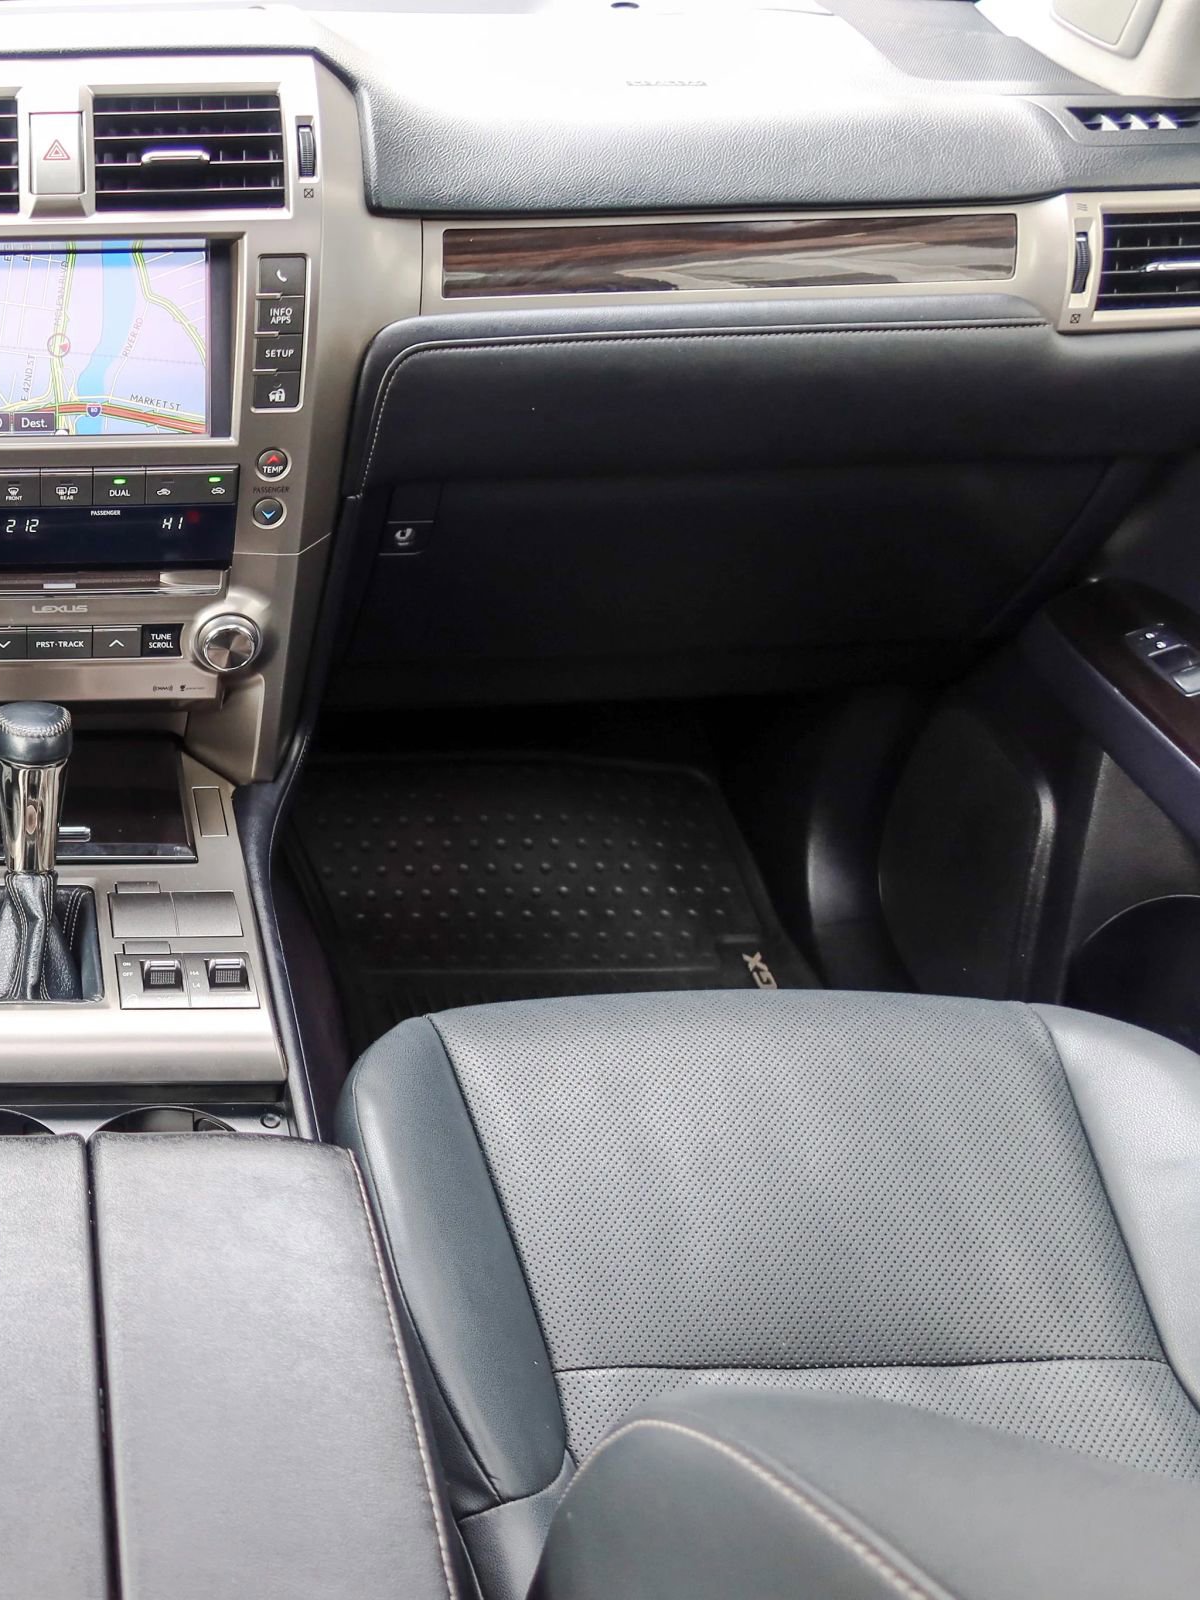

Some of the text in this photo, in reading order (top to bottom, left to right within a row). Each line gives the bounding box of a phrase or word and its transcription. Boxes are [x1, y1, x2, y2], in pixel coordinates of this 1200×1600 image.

[269, 307, 293, 317] INFO
[270, 316, 292, 325] APPS
[122, 331, 140, 358] RIVER
[264, 349, 295, 358] SETUP
[130, 394, 181, 411] MARKET ST
[21, 418, 48, 428] Dest.
[262, 465, 284, 474] TEMP
[252, 486, 290, 494] PASSENGER
[31, 605, 89, 613] LEXUS
